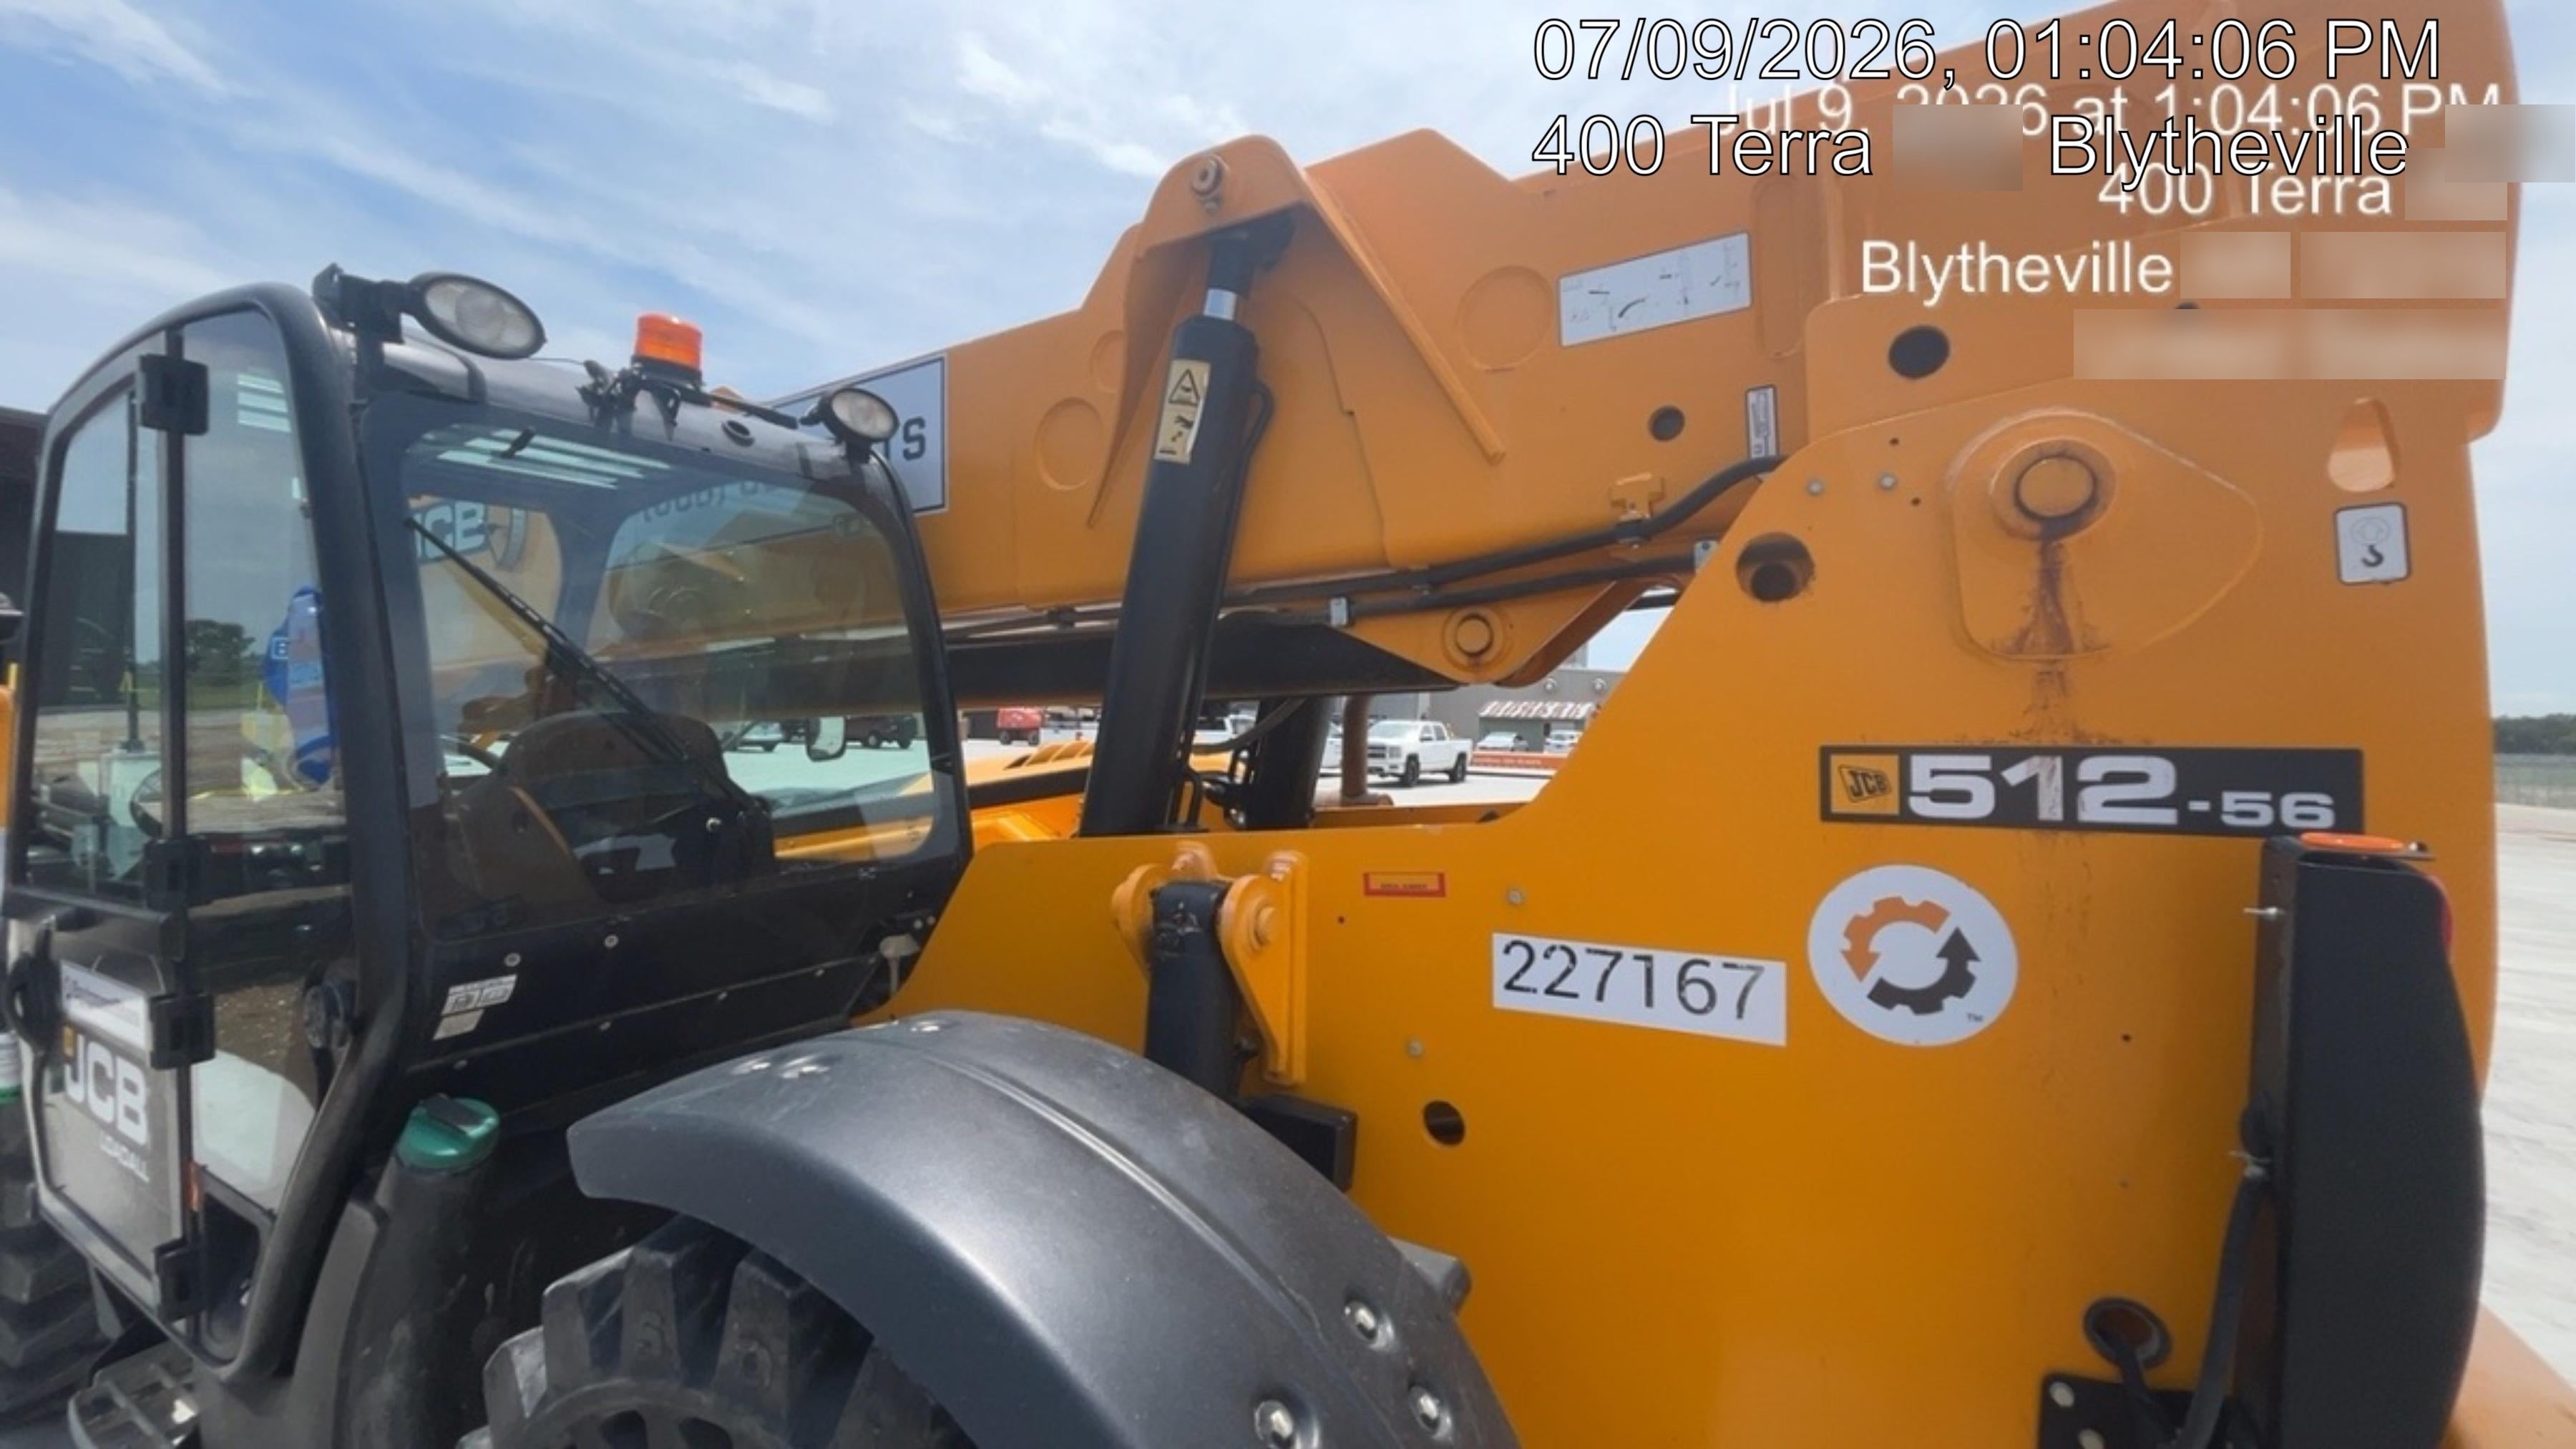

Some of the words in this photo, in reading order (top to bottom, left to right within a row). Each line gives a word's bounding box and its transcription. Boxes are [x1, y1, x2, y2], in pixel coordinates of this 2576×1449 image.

[1848, 769, 1889, 797] JCB
[1908, 753, 2336, 829] 512-56
[1502, 939, 1765, 1020] 227167
[64, 1033, 147, 1146] JCB
